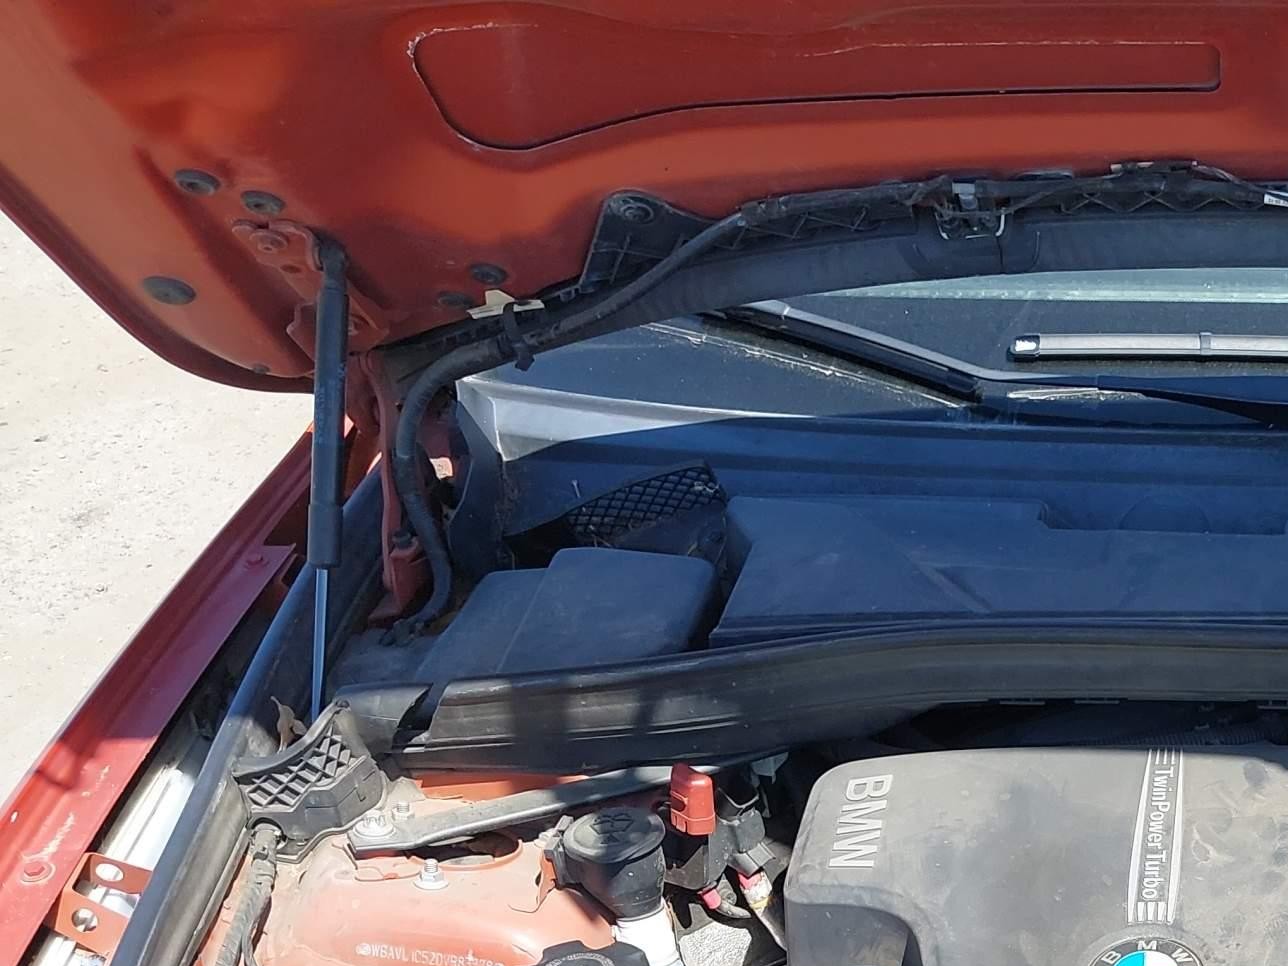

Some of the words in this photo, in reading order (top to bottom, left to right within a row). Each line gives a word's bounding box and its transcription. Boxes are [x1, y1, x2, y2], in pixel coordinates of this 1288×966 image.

[828, 774, 893, 868] BMW
[1147, 766, 1174, 850] TwinPower
[1142, 850, 1167, 900] Turbo
